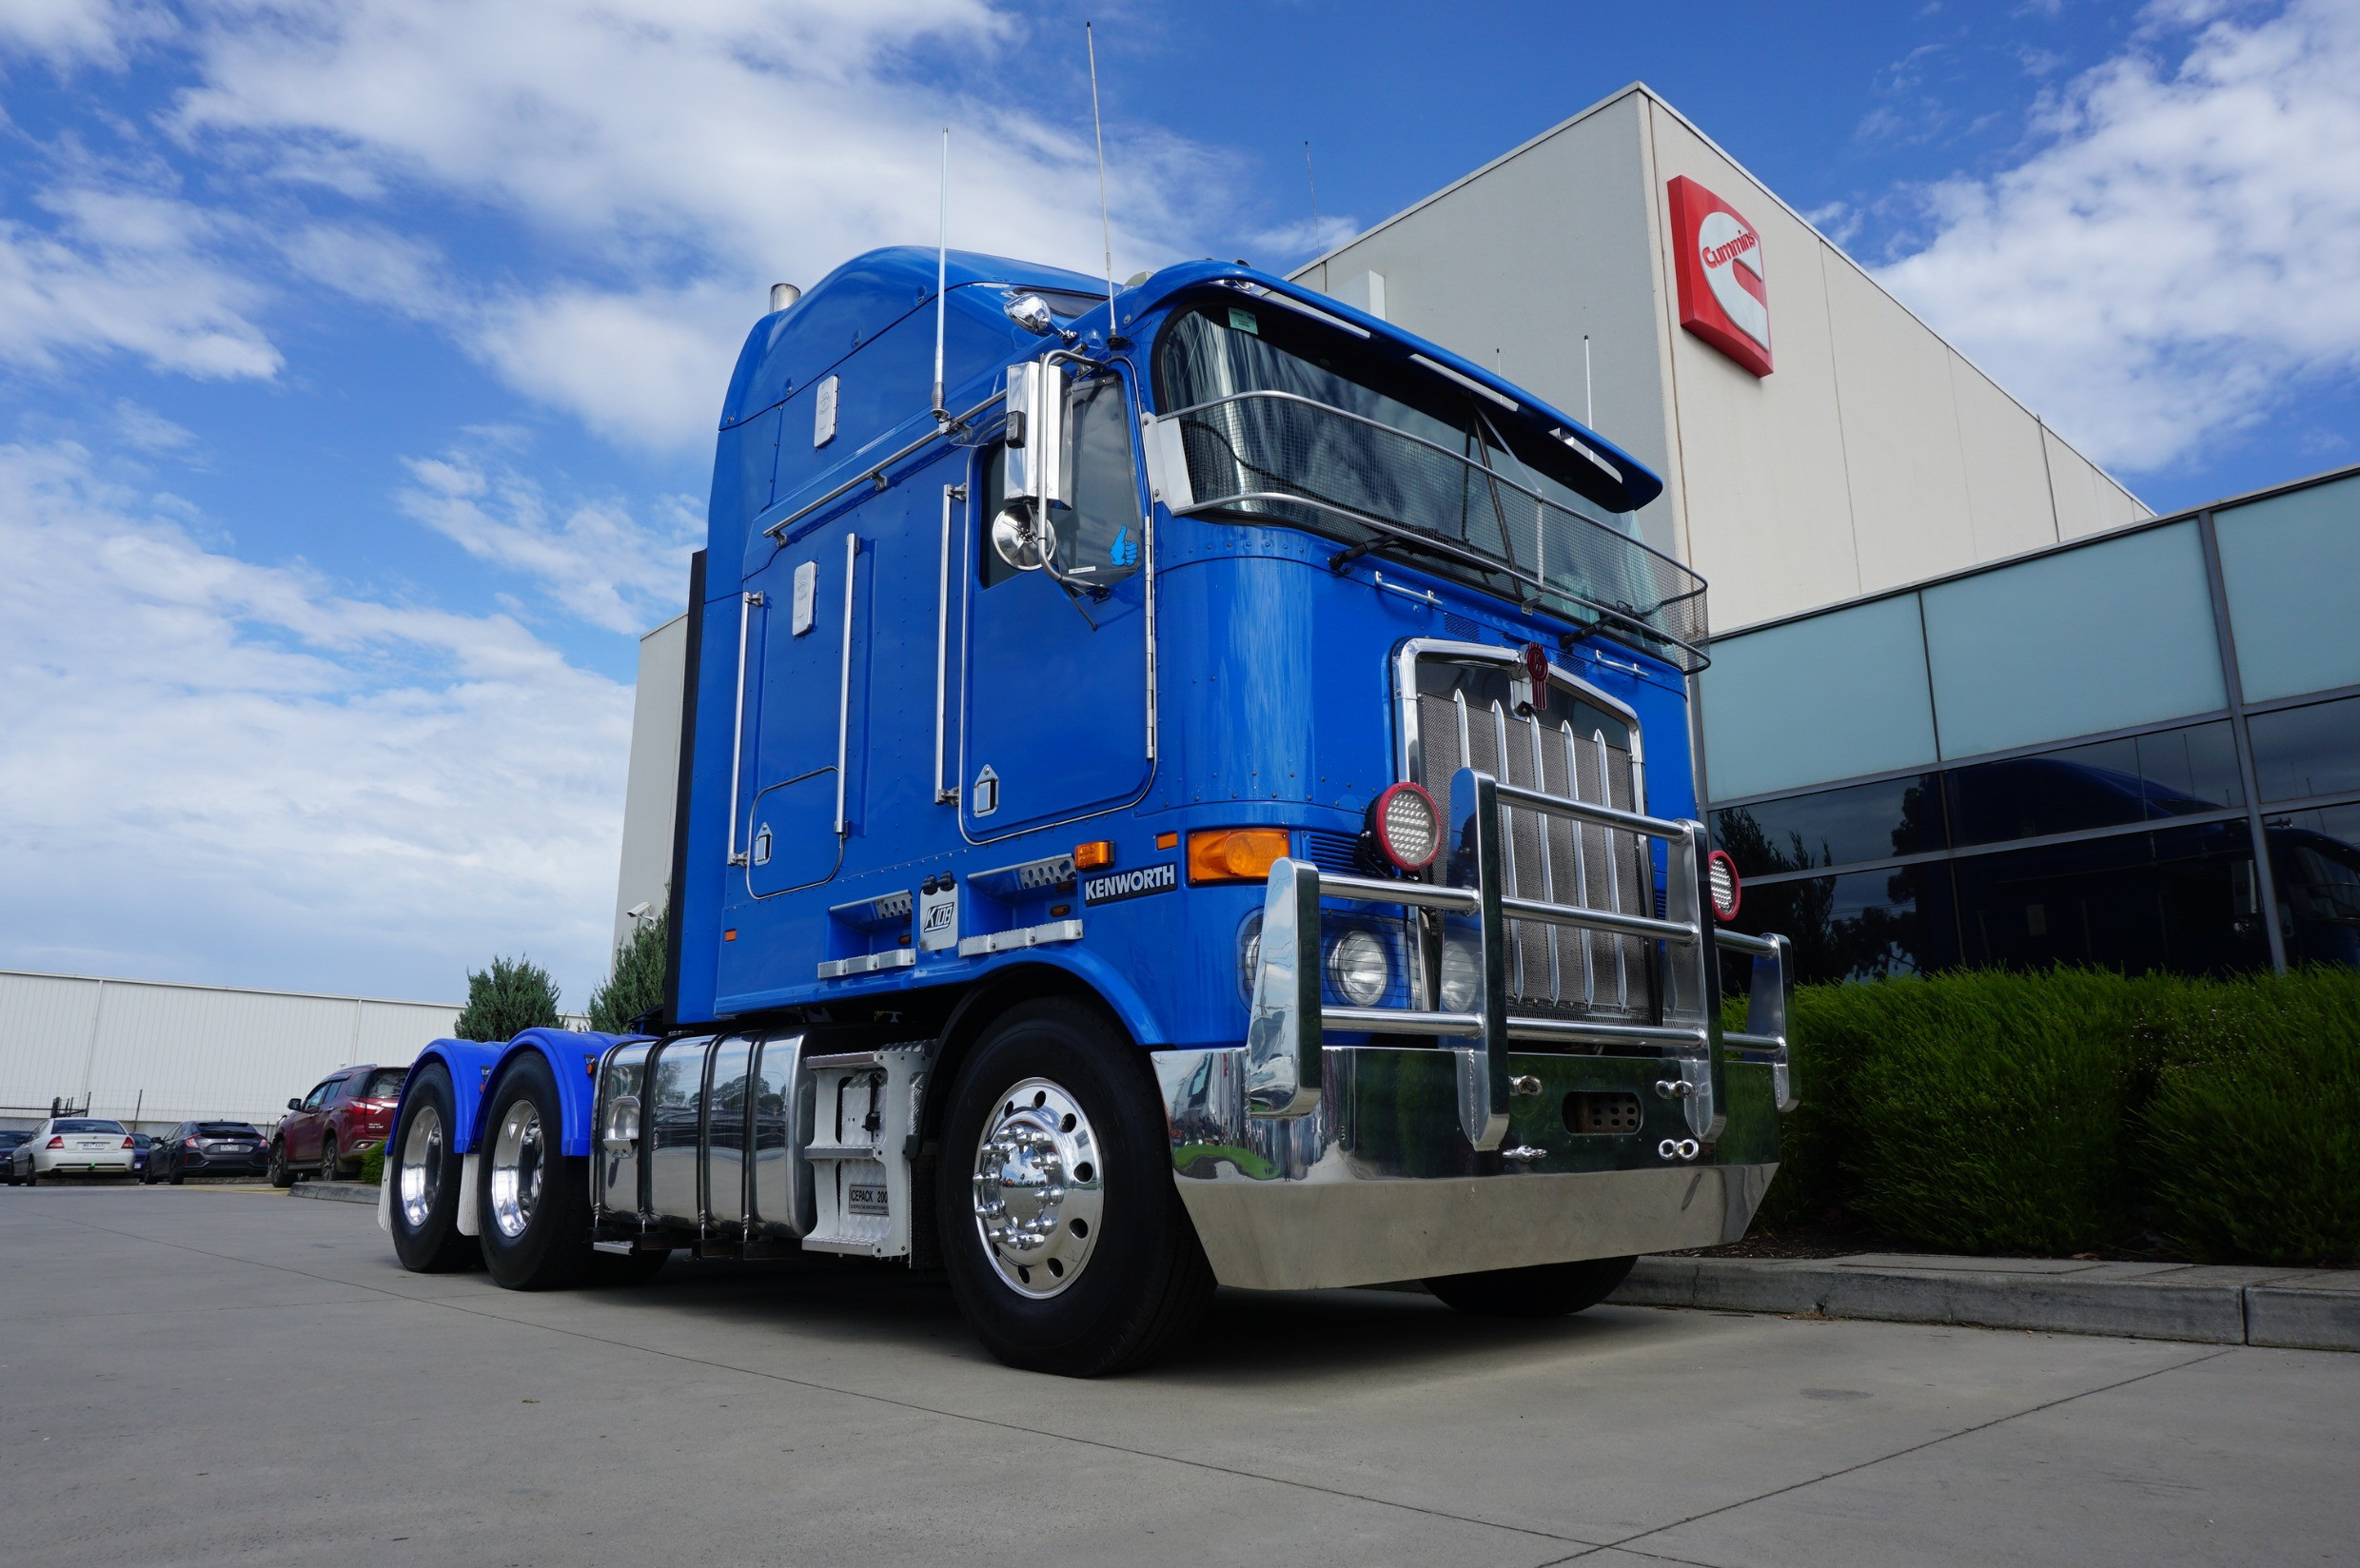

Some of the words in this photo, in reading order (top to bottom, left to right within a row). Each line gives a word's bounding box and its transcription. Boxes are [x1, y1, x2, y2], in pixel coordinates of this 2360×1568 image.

[1702, 229, 1756, 268] Cummins
[1086, 864, 1175, 900] KENWORTH
[850, 1189, 874, 1203] ICEPACK
